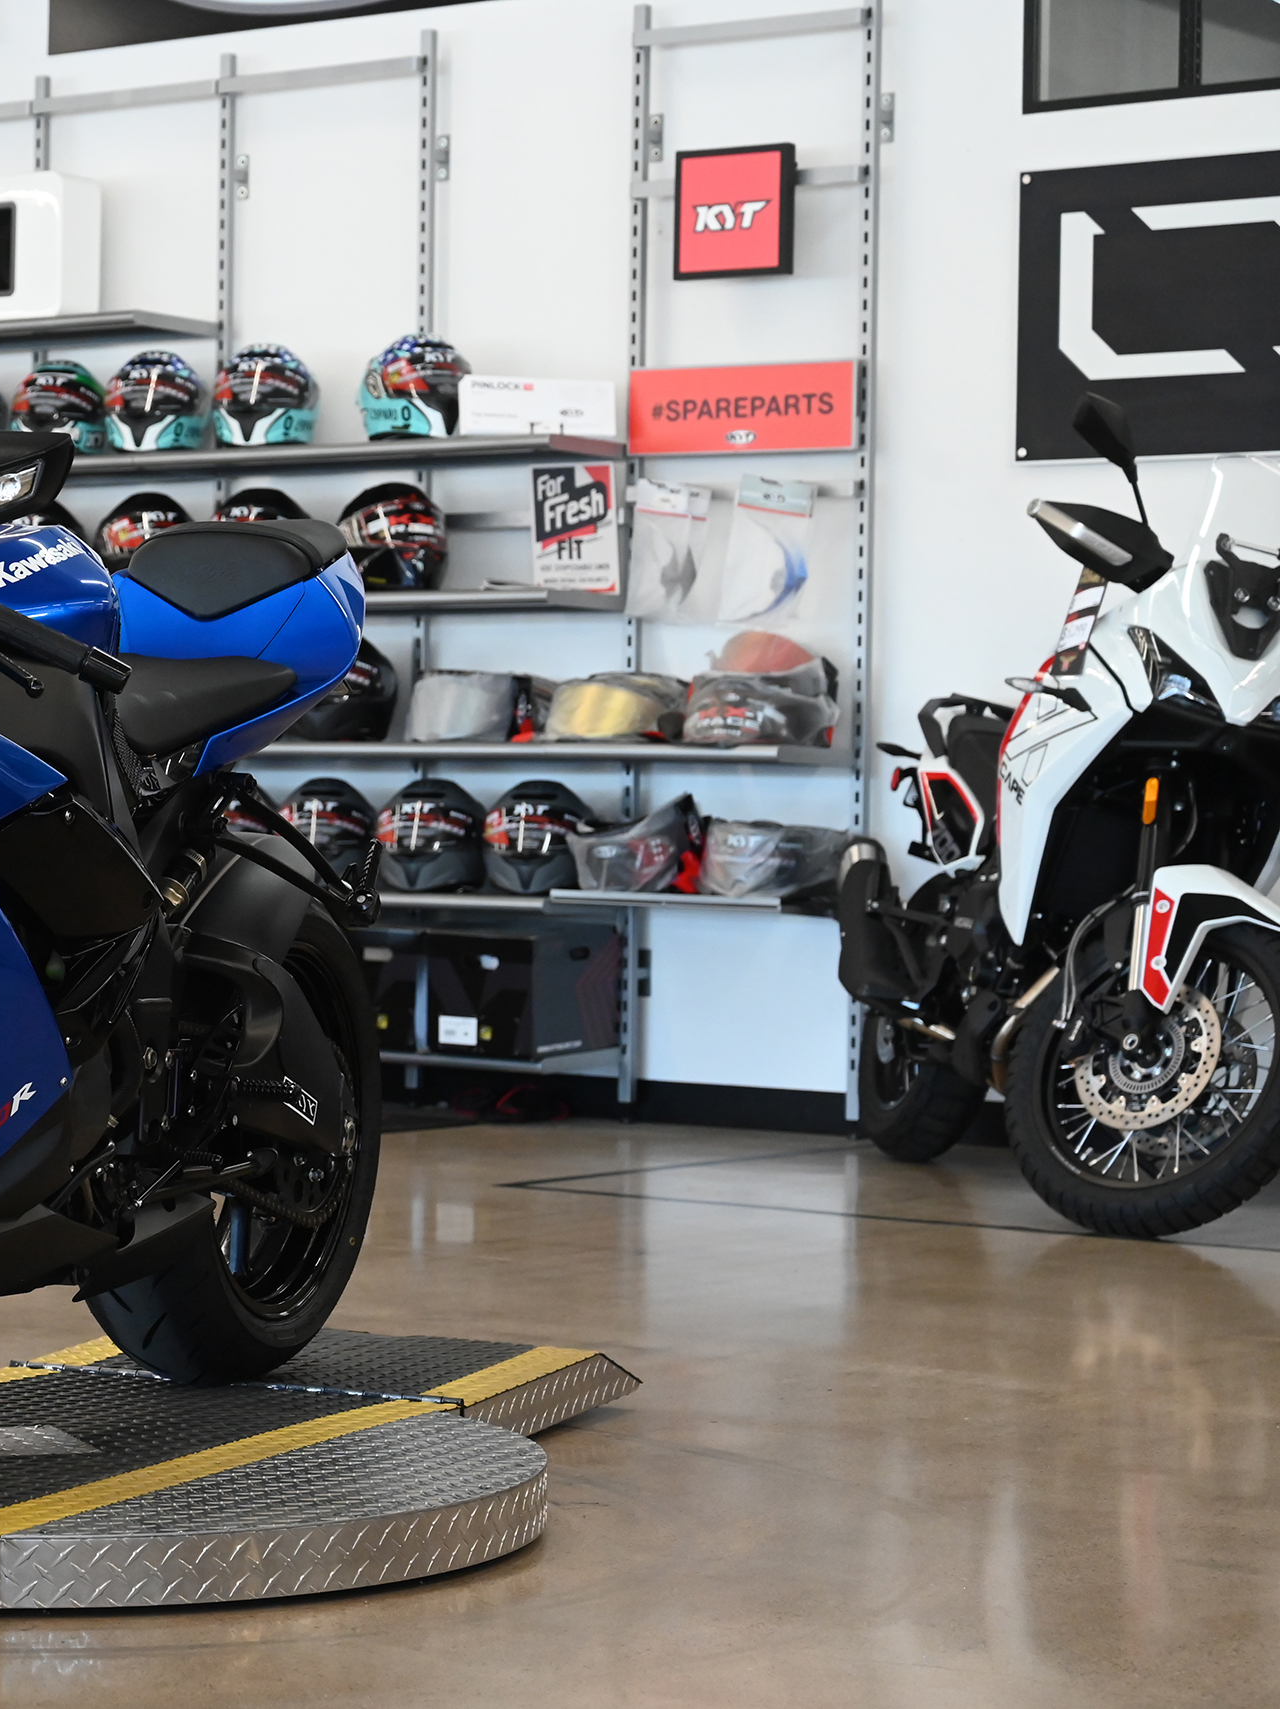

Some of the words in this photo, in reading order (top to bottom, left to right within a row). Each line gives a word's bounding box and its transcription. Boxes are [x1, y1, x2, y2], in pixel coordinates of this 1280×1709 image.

[693, 199, 772, 234] KYT
[651, 391, 835, 422] #SPAREPARTS
[537, 473, 565, 501] For
[543, 488, 605, 533] Fresh
[557, 537, 584, 560] FIT
[999, 762, 1025, 806] CAPE
